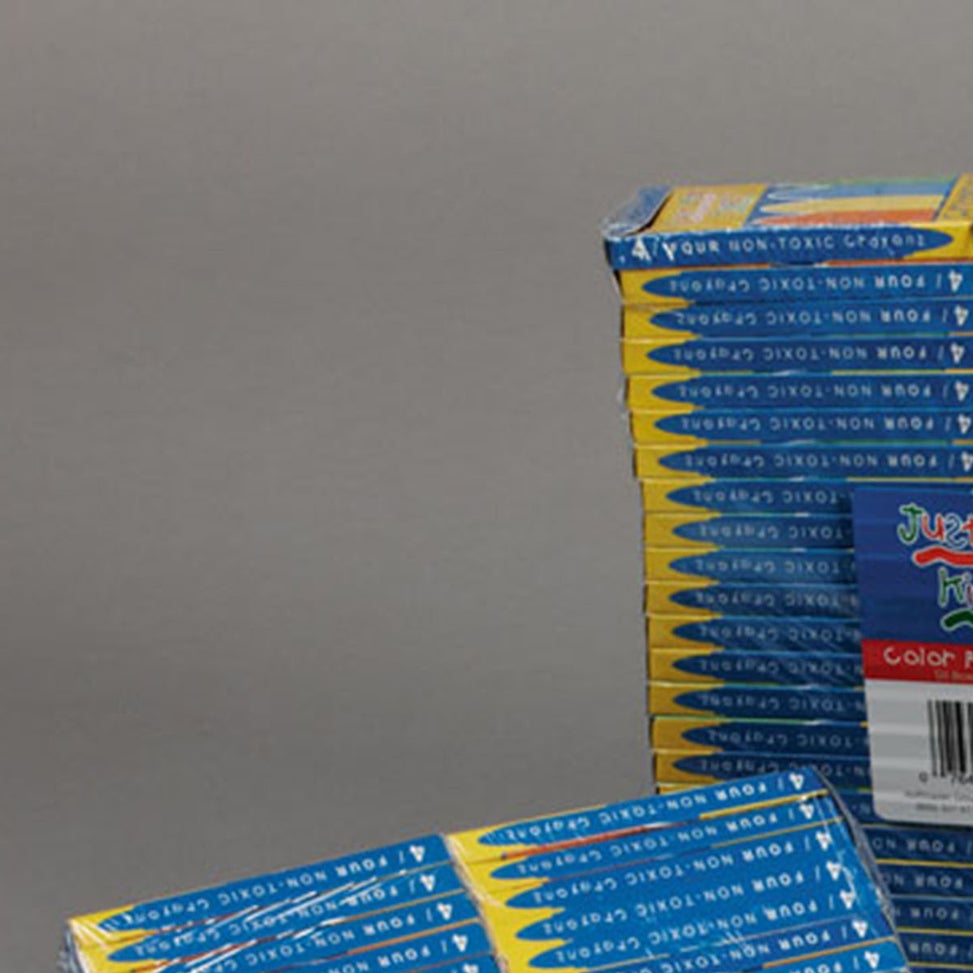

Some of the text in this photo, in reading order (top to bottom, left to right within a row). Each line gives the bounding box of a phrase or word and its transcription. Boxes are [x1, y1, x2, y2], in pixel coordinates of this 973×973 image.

[874, 274, 924, 288] FOUR
[876, 346, 926, 359] FOUR
[884, 416, 934, 430] FOUR
[883, 646, 956, 671] Color
[741, 841, 794, 862] FOUR
[778, 930, 830, 950] FOUR
